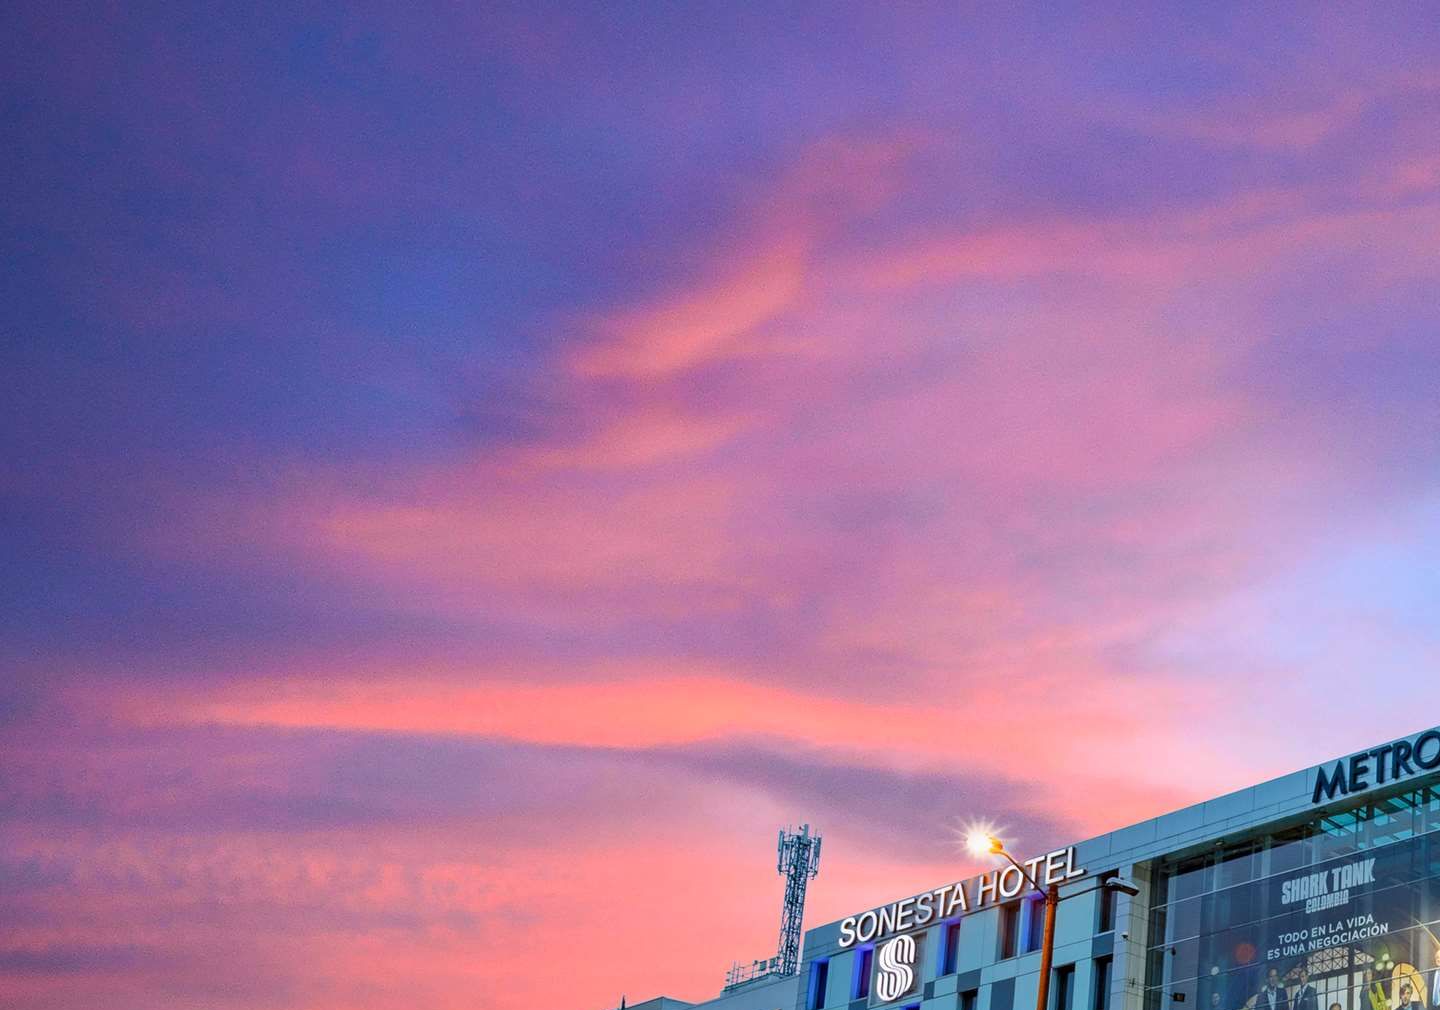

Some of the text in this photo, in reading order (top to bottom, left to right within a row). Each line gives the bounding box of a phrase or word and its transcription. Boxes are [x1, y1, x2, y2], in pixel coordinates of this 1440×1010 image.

[838, 846, 1086, 948] SONESTA HOTEL
[1281, 858, 1376, 905] SHARK TANK
[1305, 889, 1350, 914] COLOMBIA
[1267, 922, 1389, 960] ES UNA NEGOCIACIÓN
[1278, 913, 1375, 945] TODO EN LA VIDA
